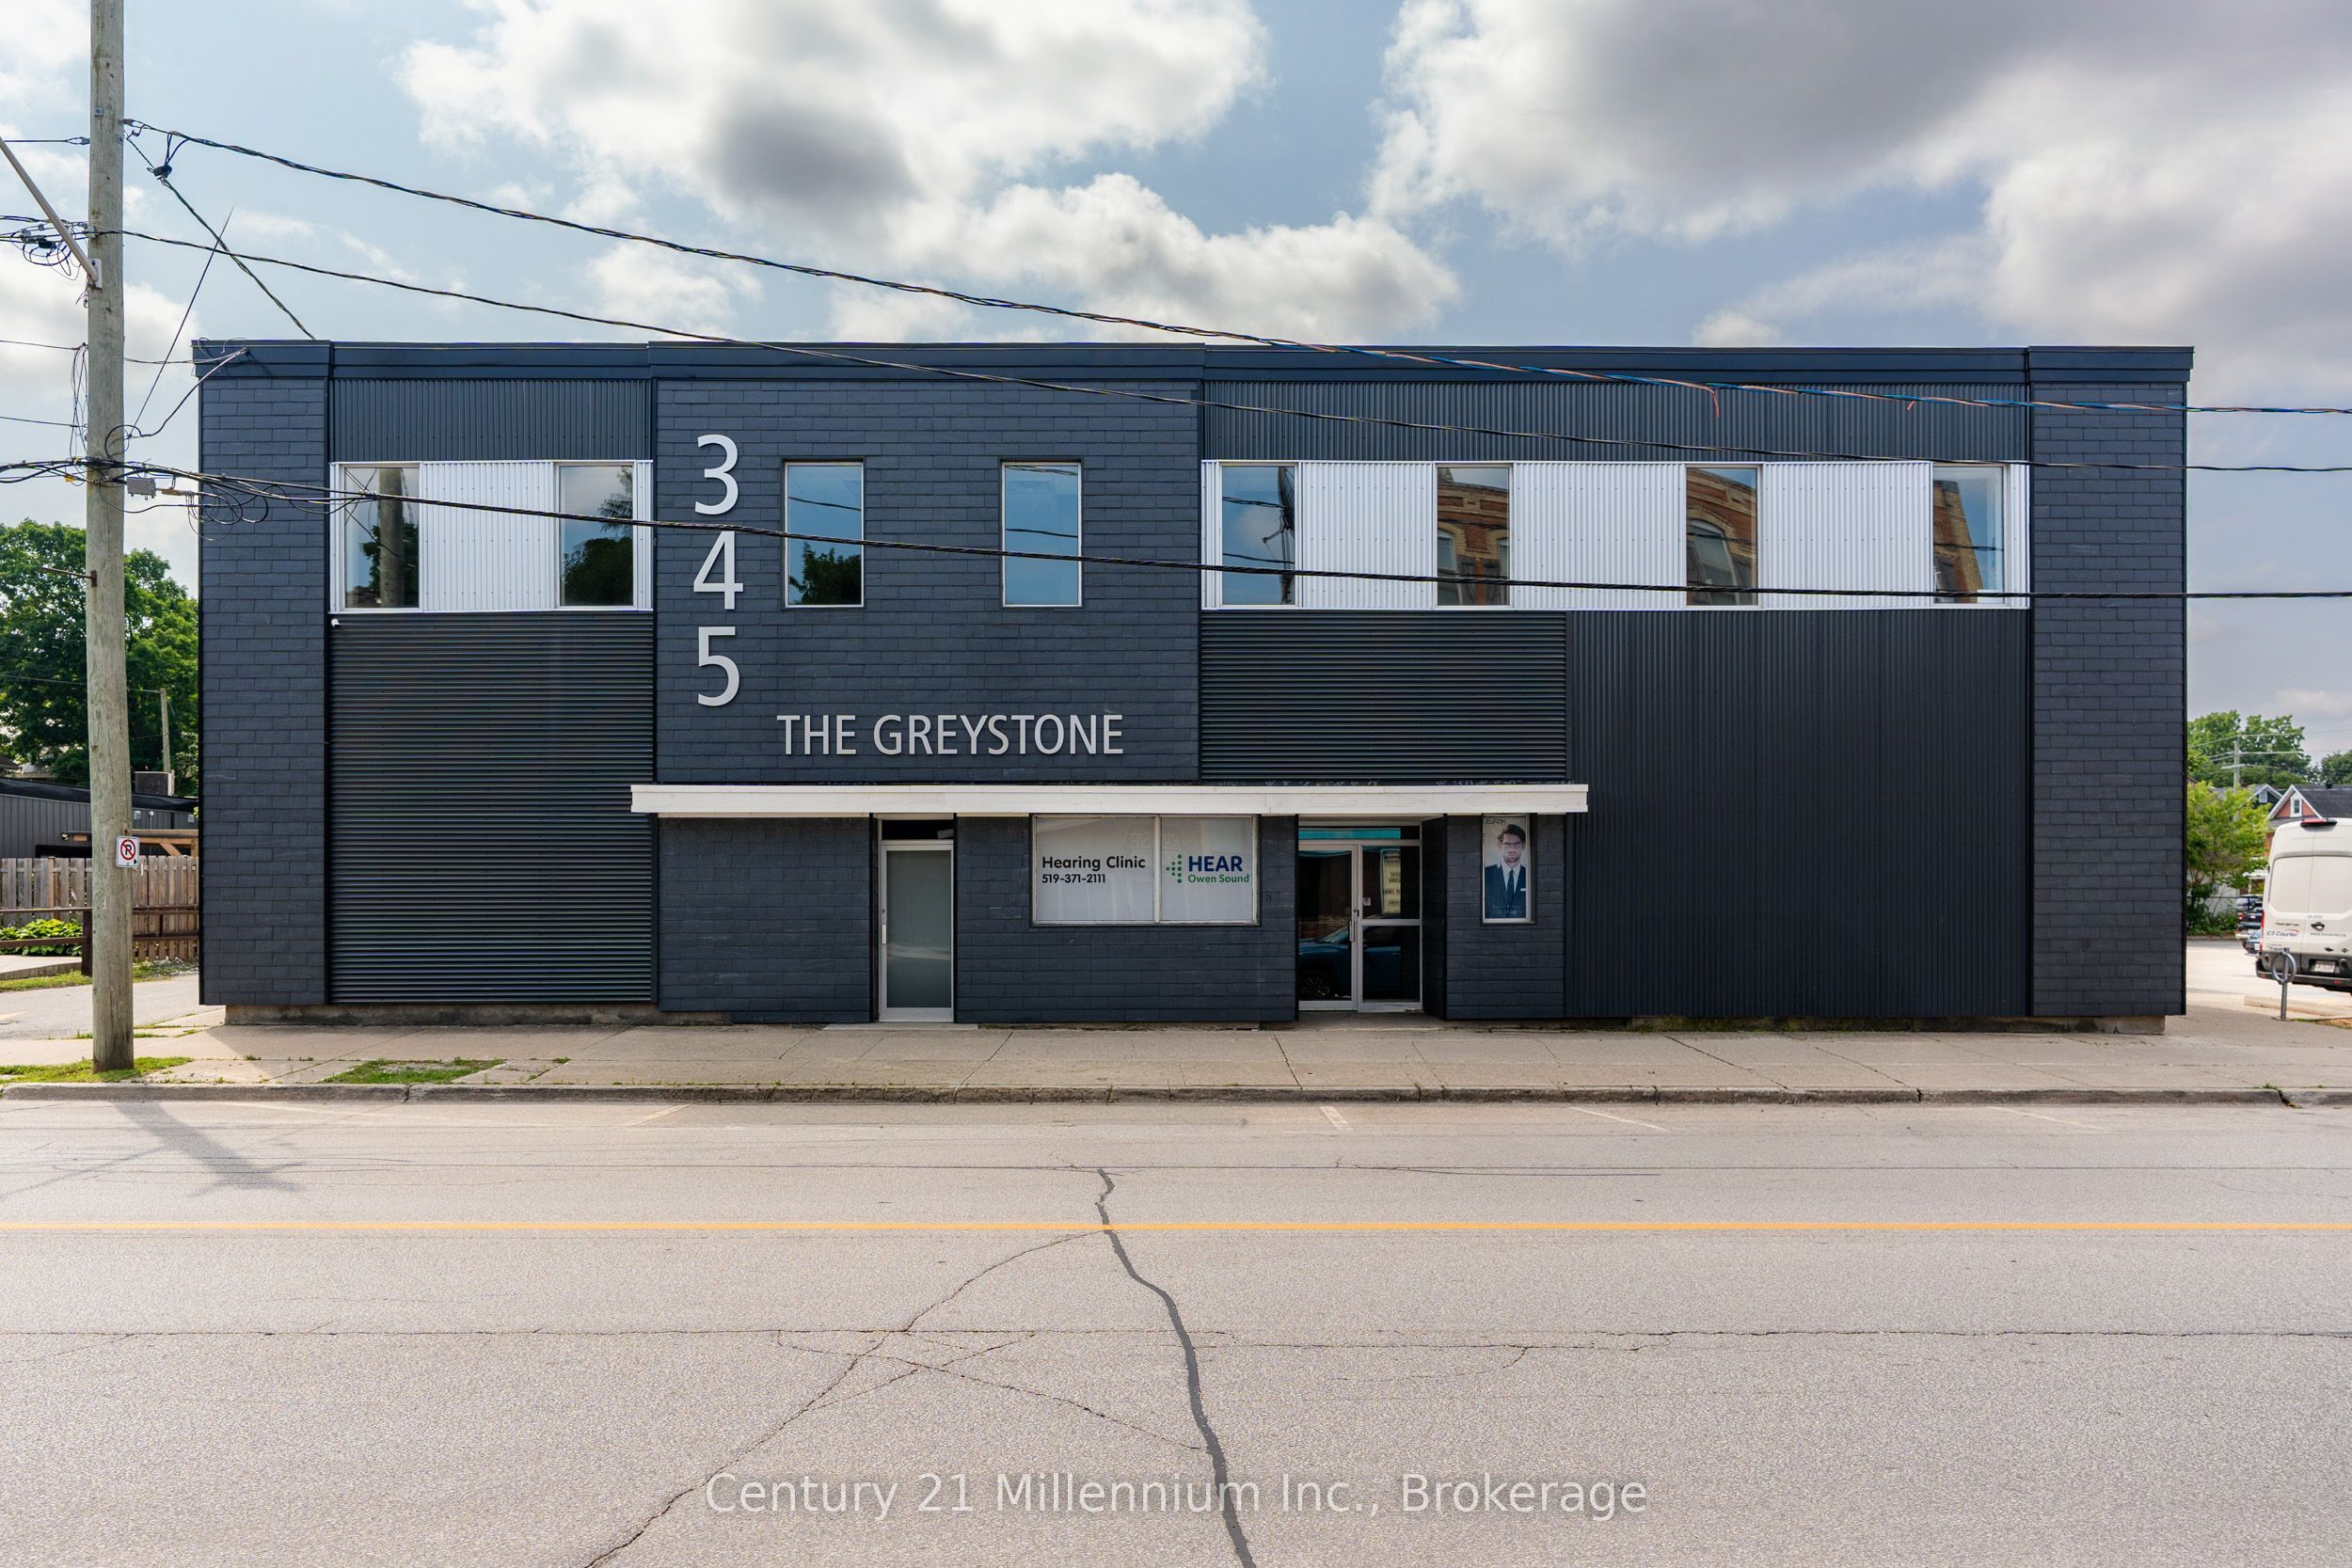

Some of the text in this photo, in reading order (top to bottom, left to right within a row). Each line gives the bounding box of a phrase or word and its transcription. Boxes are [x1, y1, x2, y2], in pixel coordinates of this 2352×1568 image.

[693, 434, 744, 706] 345
[776, 714, 1123, 755] THE GREYSTONE
[1041, 855, 1146, 871] Hearing Clinic
[1188, 855, 1244, 872] HEAR
[1041, 873, 1105, 884] 519-371-2111
[1188, 874, 1250, 883] Owen Sound
